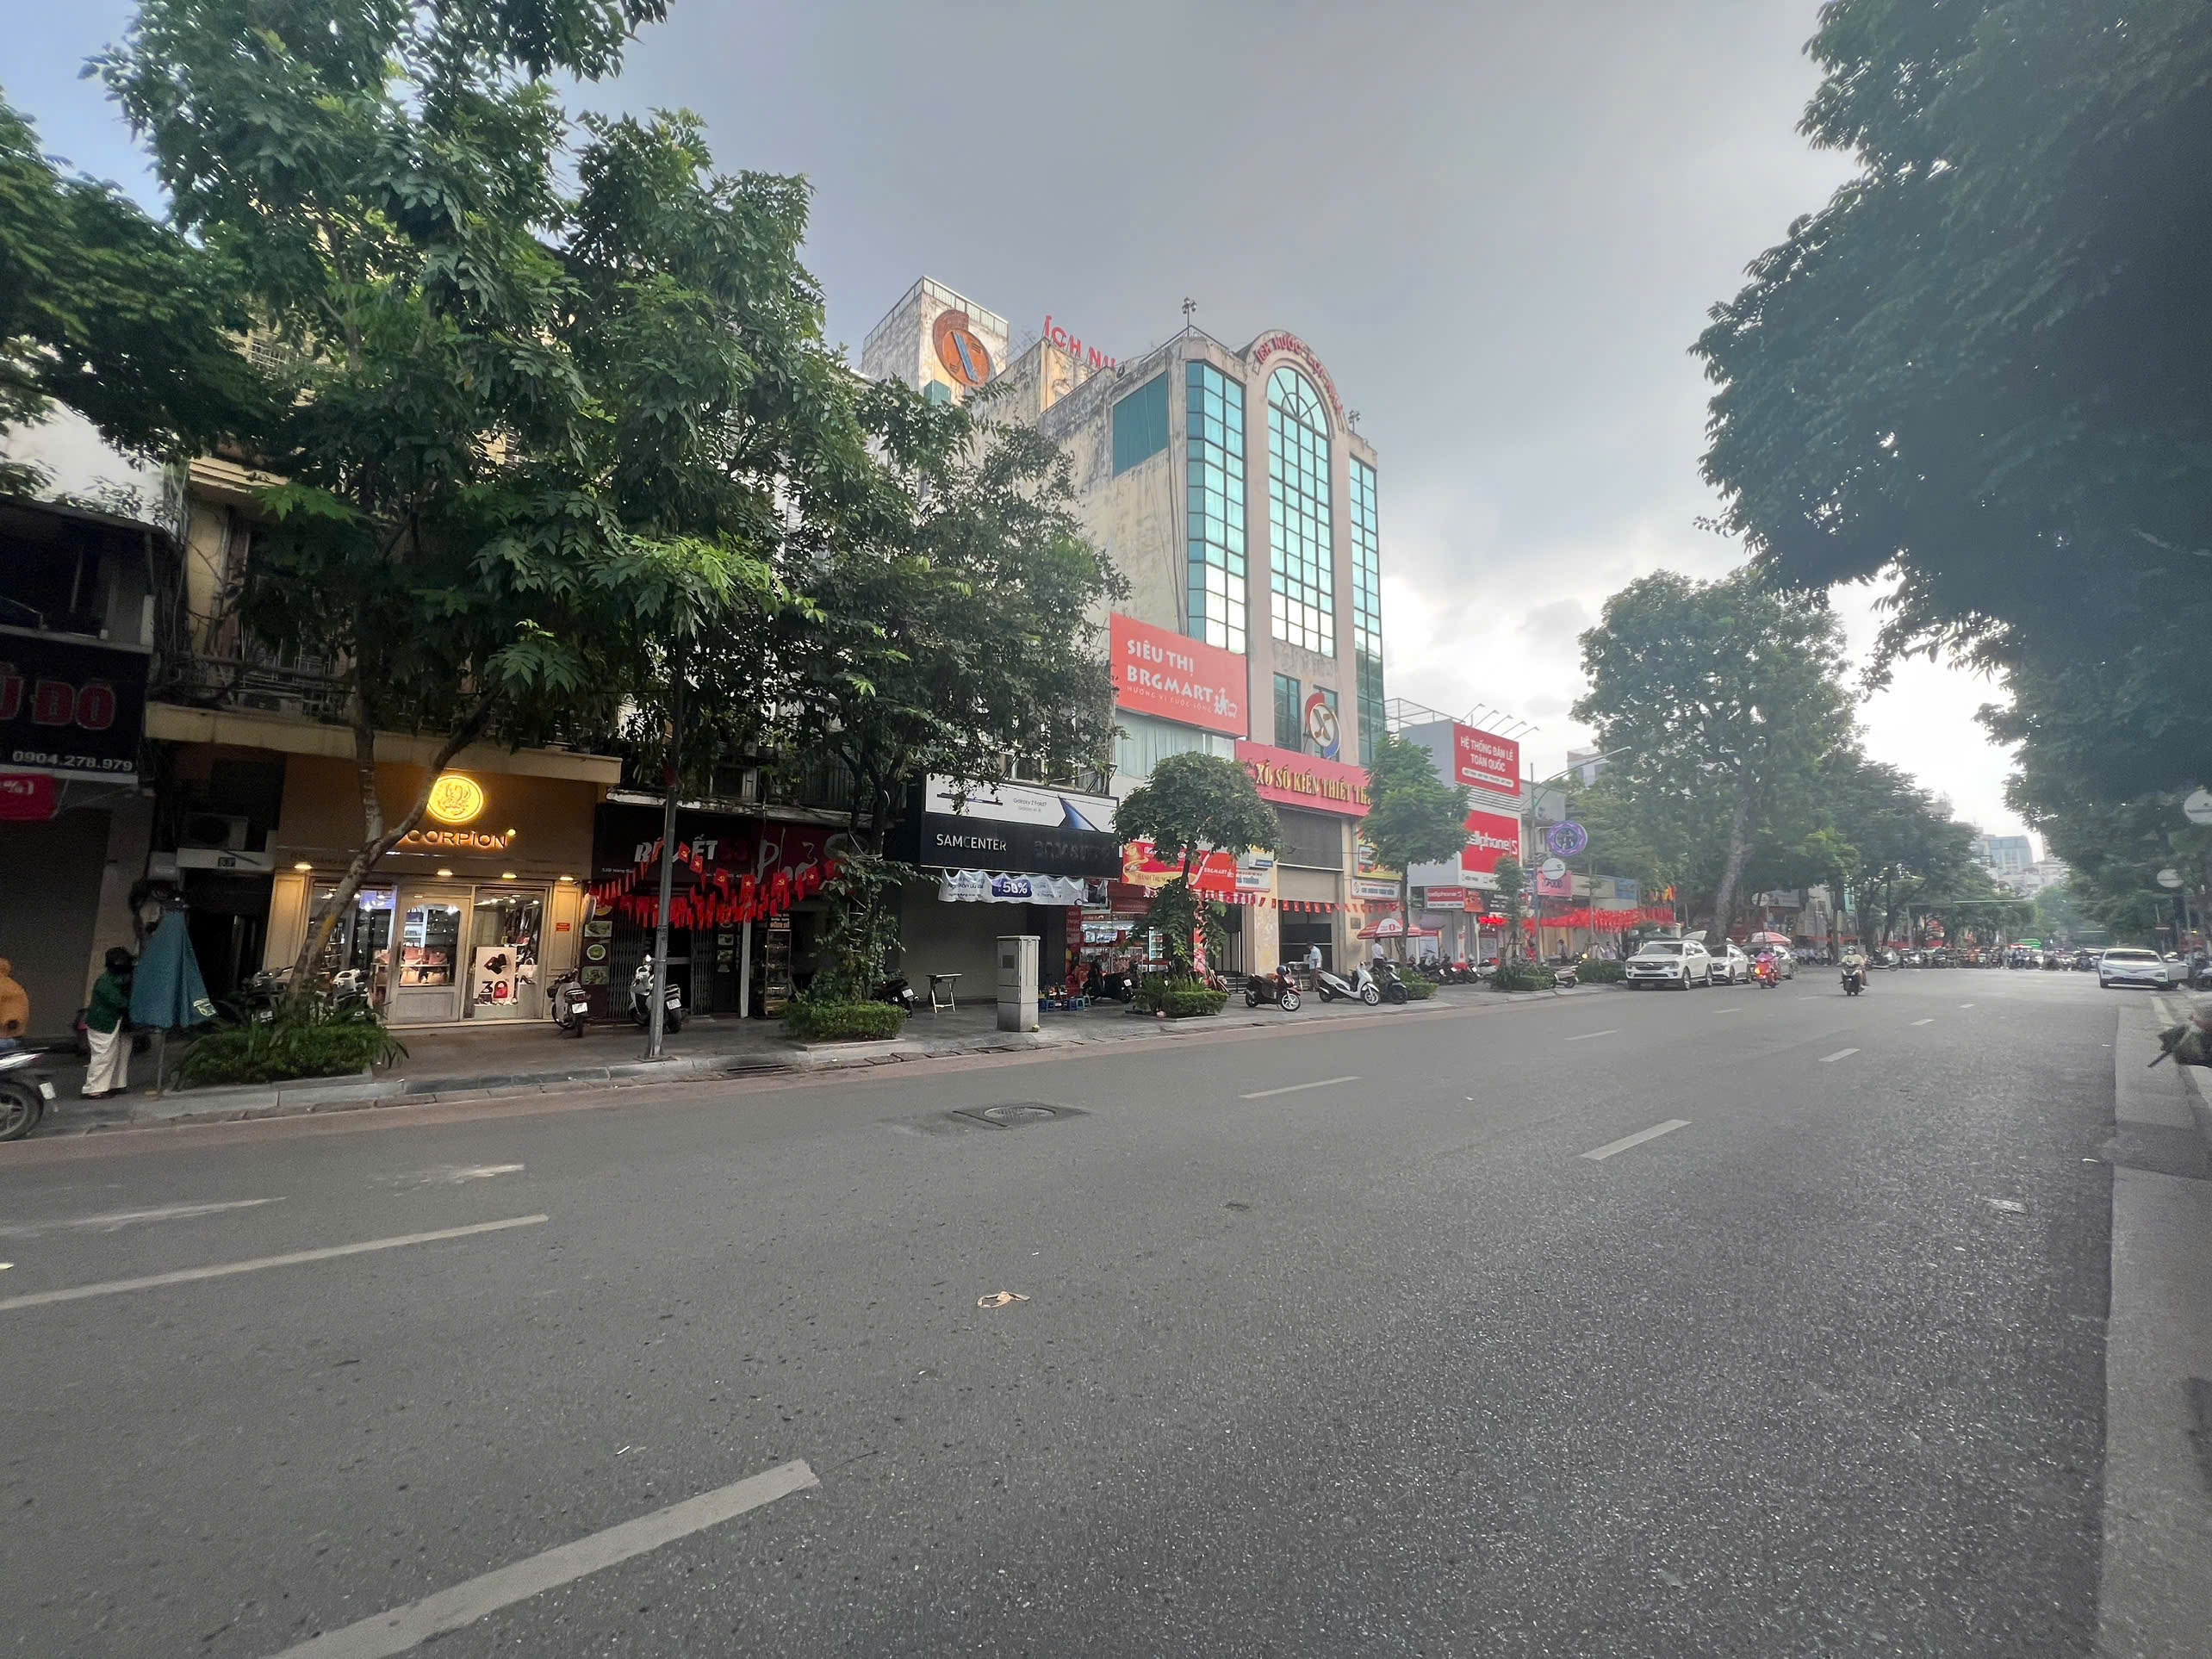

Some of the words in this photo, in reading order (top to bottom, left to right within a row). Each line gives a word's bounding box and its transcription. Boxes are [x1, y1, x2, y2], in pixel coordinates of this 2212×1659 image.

[1127, 639, 1163, 663] SIÊU
[1166, 650, 1194, 677] THỊ
[1127, 664, 1213, 703] BRGMART
[1460, 736, 1469, 750] HỆ
[1470, 739, 1492, 755] THỐNG
[1493, 746, 1506, 759] BÁN
[12, 750, 133, 772] 0904.278.979
[1469, 753, 1488, 767] TOÀN
[1488, 759, 1507, 773] QUỐC
[1276, 764, 1290, 790] SỐ
[1293, 768, 1319, 795] KIẾN
[1321, 776, 1351, 803] THIẾT
[400, 830, 506, 848] CORPION
[936, 833, 1007, 852] SAMCENTER
[1002, 881, 1028, 894] 50%
